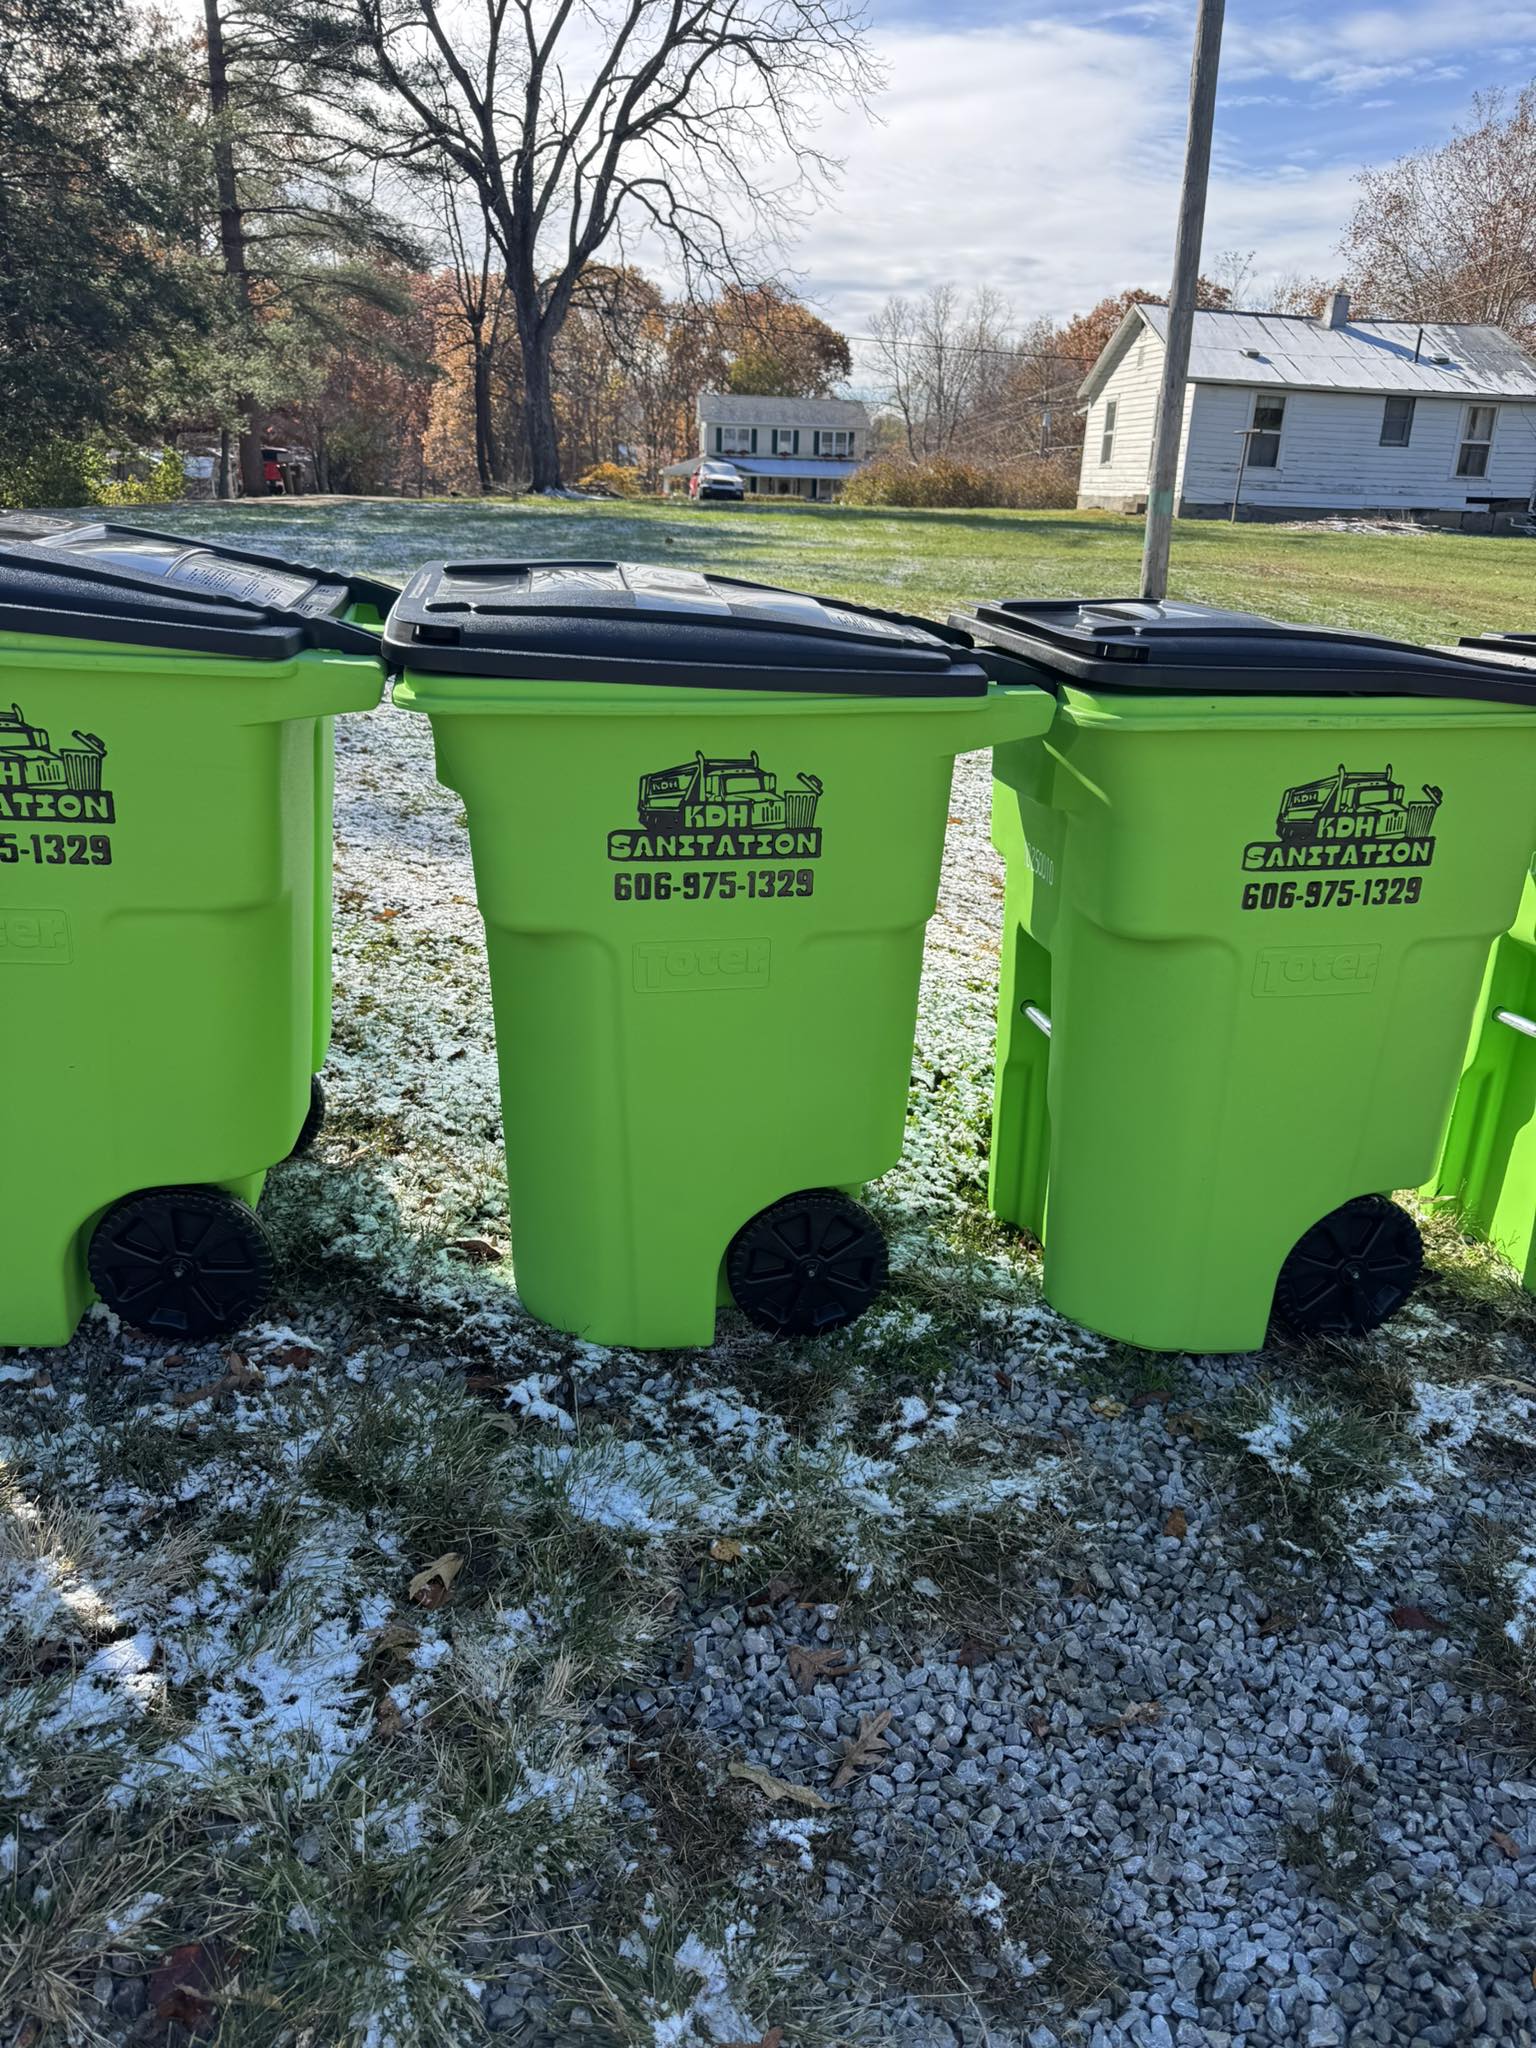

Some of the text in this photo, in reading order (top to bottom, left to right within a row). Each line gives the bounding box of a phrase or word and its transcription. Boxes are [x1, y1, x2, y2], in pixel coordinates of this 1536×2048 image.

[1293, 793, 1318, 804] KDH
[683, 804, 749, 828] KDH
[1316, 816, 1376, 839] KDH
[610, 832, 818, 858] SANITATION
[1244, 841, 1431, 869] SANITATION
[614, 868, 814, 900] 606-975-1329
[1241, 876, 1423, 910] 606-975-1329
[638, 942, 768, 988] Toter
[1260, 947, 1377, 993] Toter
